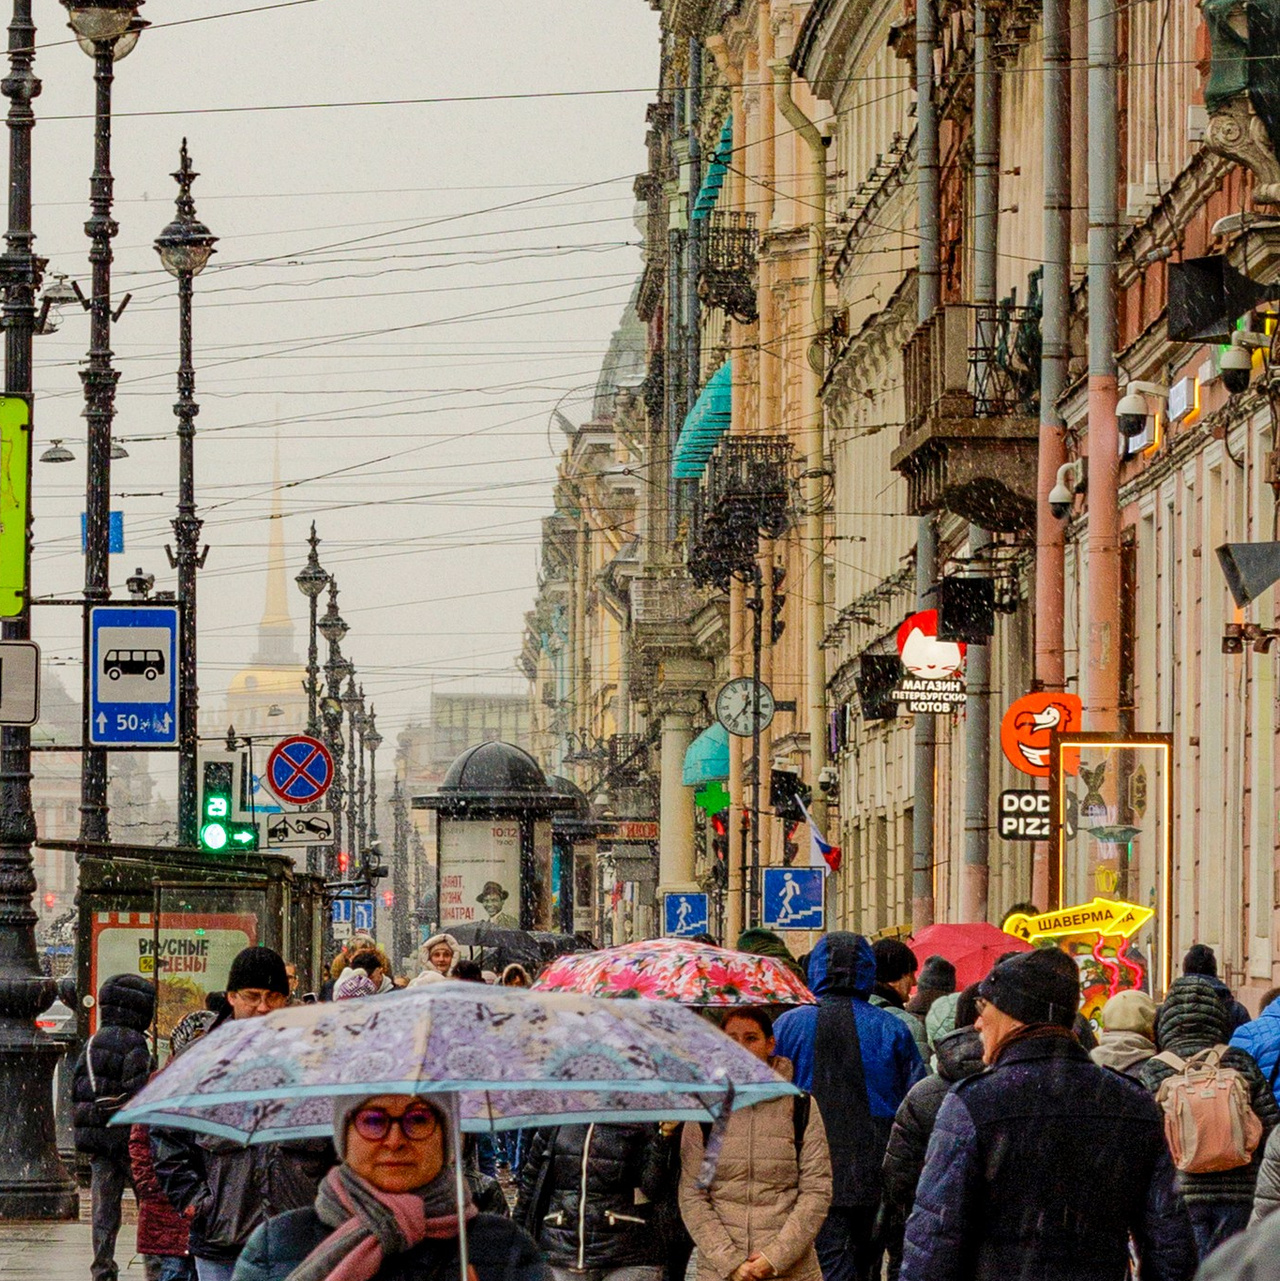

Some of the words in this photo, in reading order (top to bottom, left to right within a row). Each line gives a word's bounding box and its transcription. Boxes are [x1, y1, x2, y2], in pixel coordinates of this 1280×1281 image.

[902, 679, 961, 692] МАГАЗИН
[910, 701, 951, 713] КОТОВ
[1003, 794, 1071, 812] DOD
[1038, 909, 1114, 931] ШАВЕРМА
[139, 938, 209, 956] ВКУСНЫЕ
[162, 956, 207, 973] ЦЕНЫ
